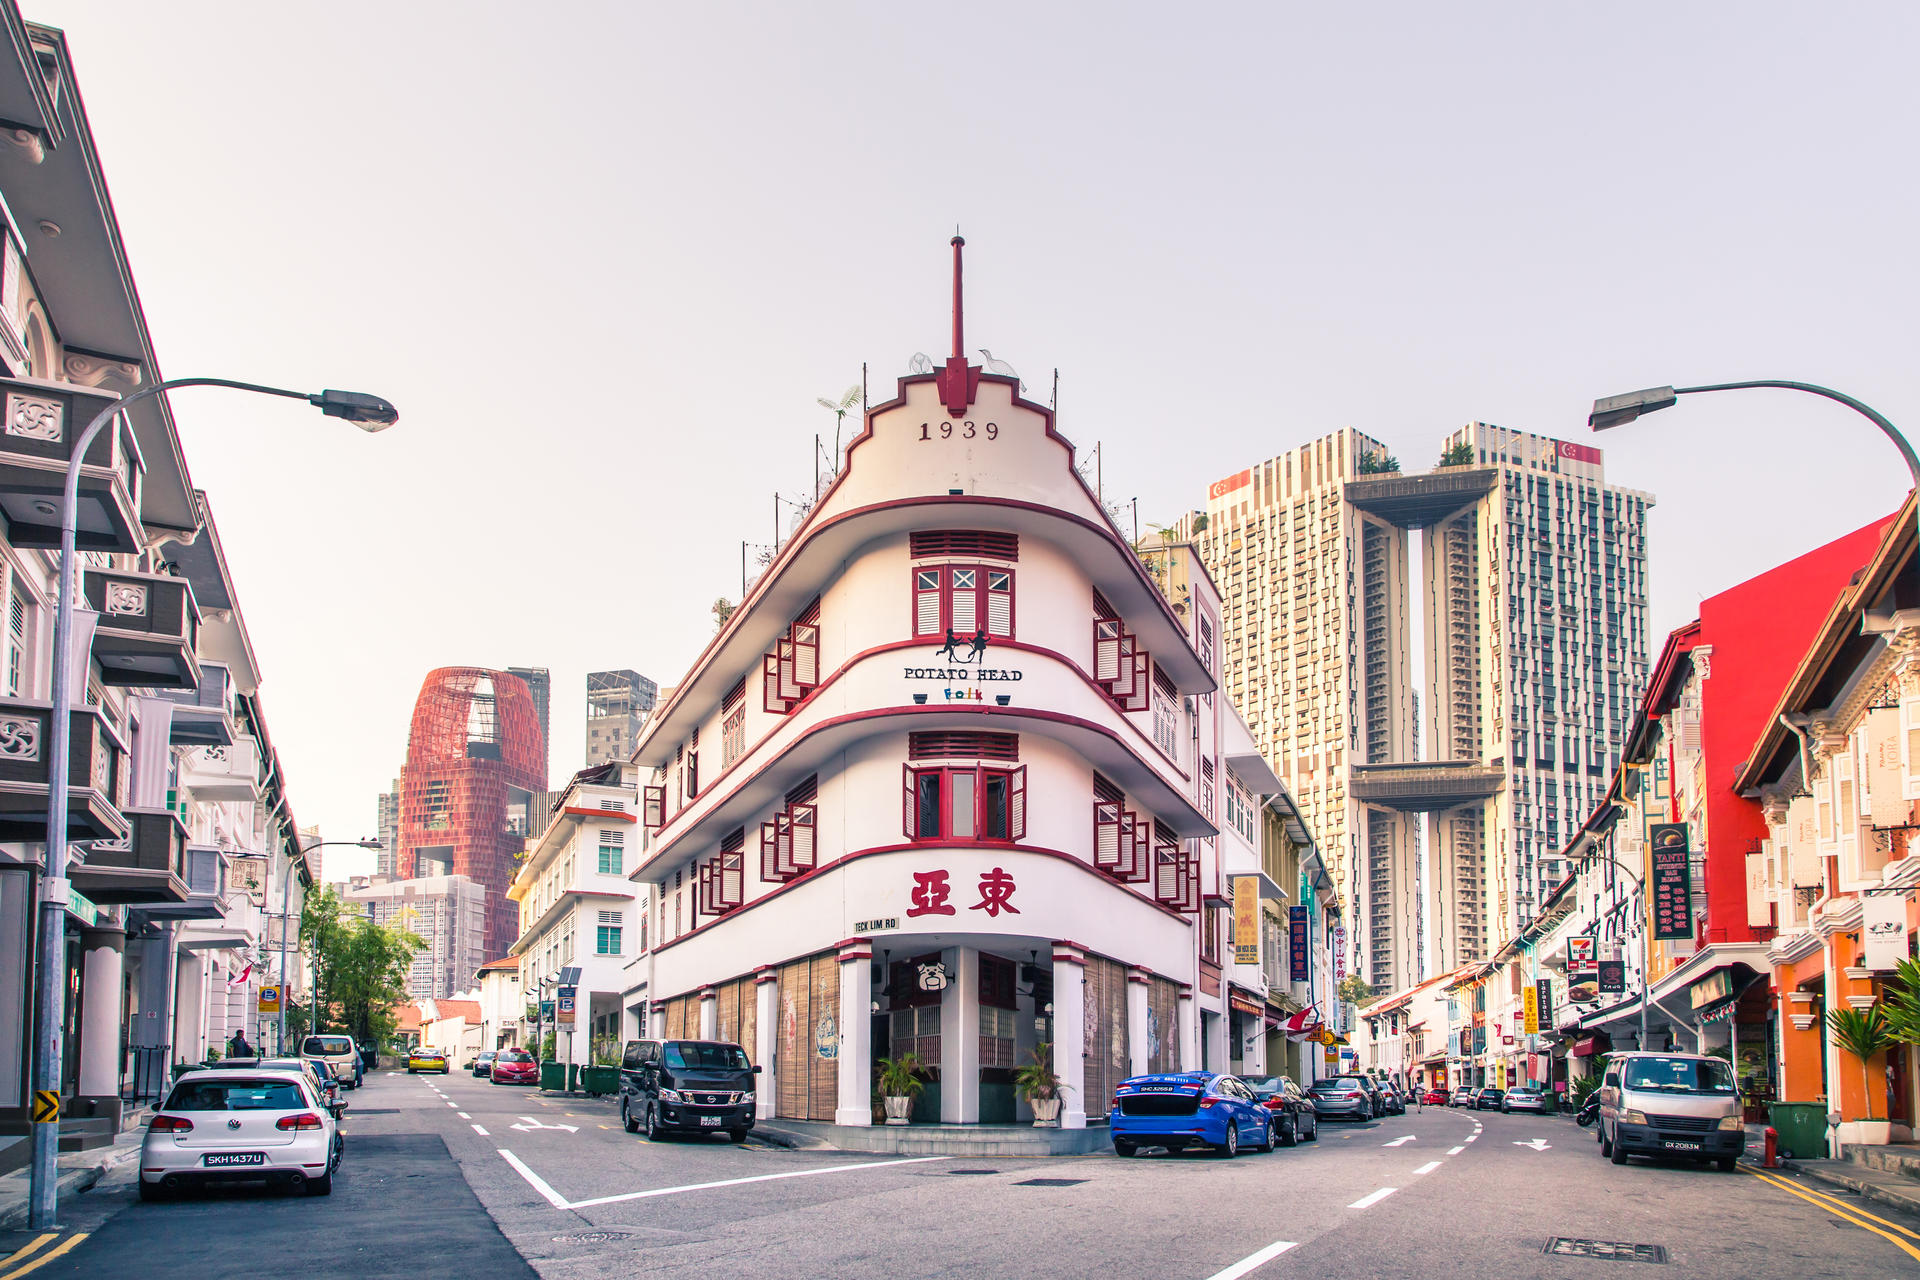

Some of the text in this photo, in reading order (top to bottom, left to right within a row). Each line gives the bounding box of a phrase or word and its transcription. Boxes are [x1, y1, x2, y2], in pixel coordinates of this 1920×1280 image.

[918, 420, 999, 441] 1939
[904, 668, 1023, 681] POTATO HEAD
[944, 687, 983, 700] Folk
[1656, 853, 1686, 863] YANTI
[855, 919, 896, 932] TECK LIM RD
